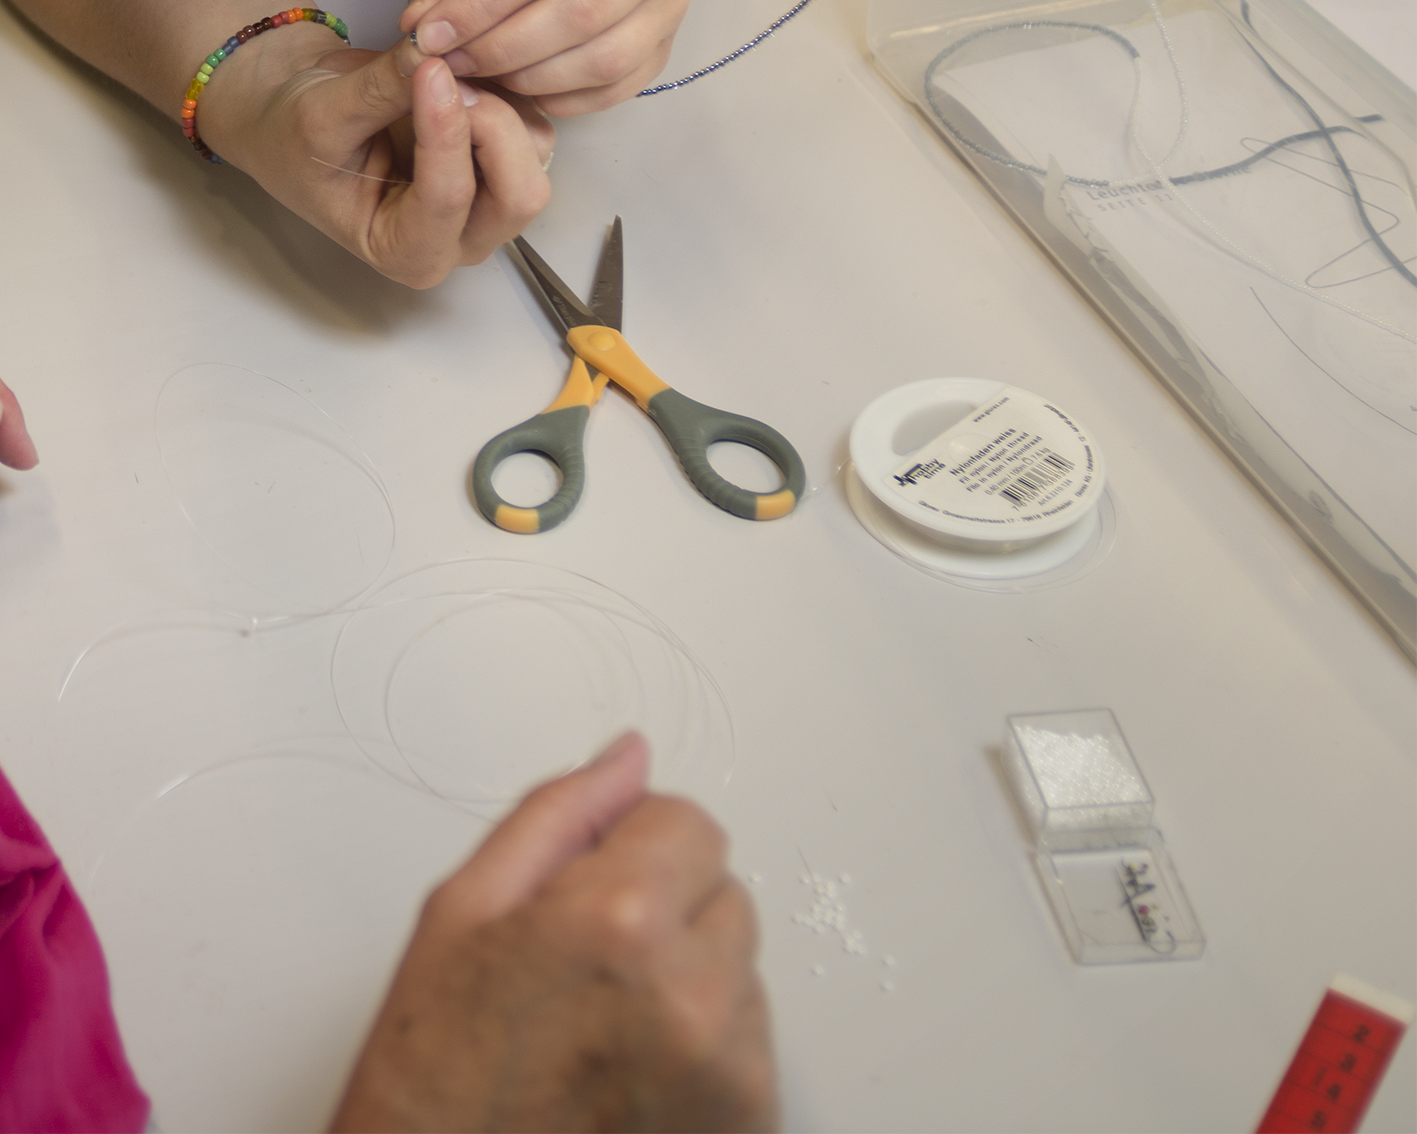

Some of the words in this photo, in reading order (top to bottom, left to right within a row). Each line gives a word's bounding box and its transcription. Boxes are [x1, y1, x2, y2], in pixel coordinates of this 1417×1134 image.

[1097, 197, 1146, 212] SEITE
[949, 443, 995, 475] Nylonfaden
[993, 428, 1016, 444] weiss
[1353, 1025, 1369, 1044] 2
